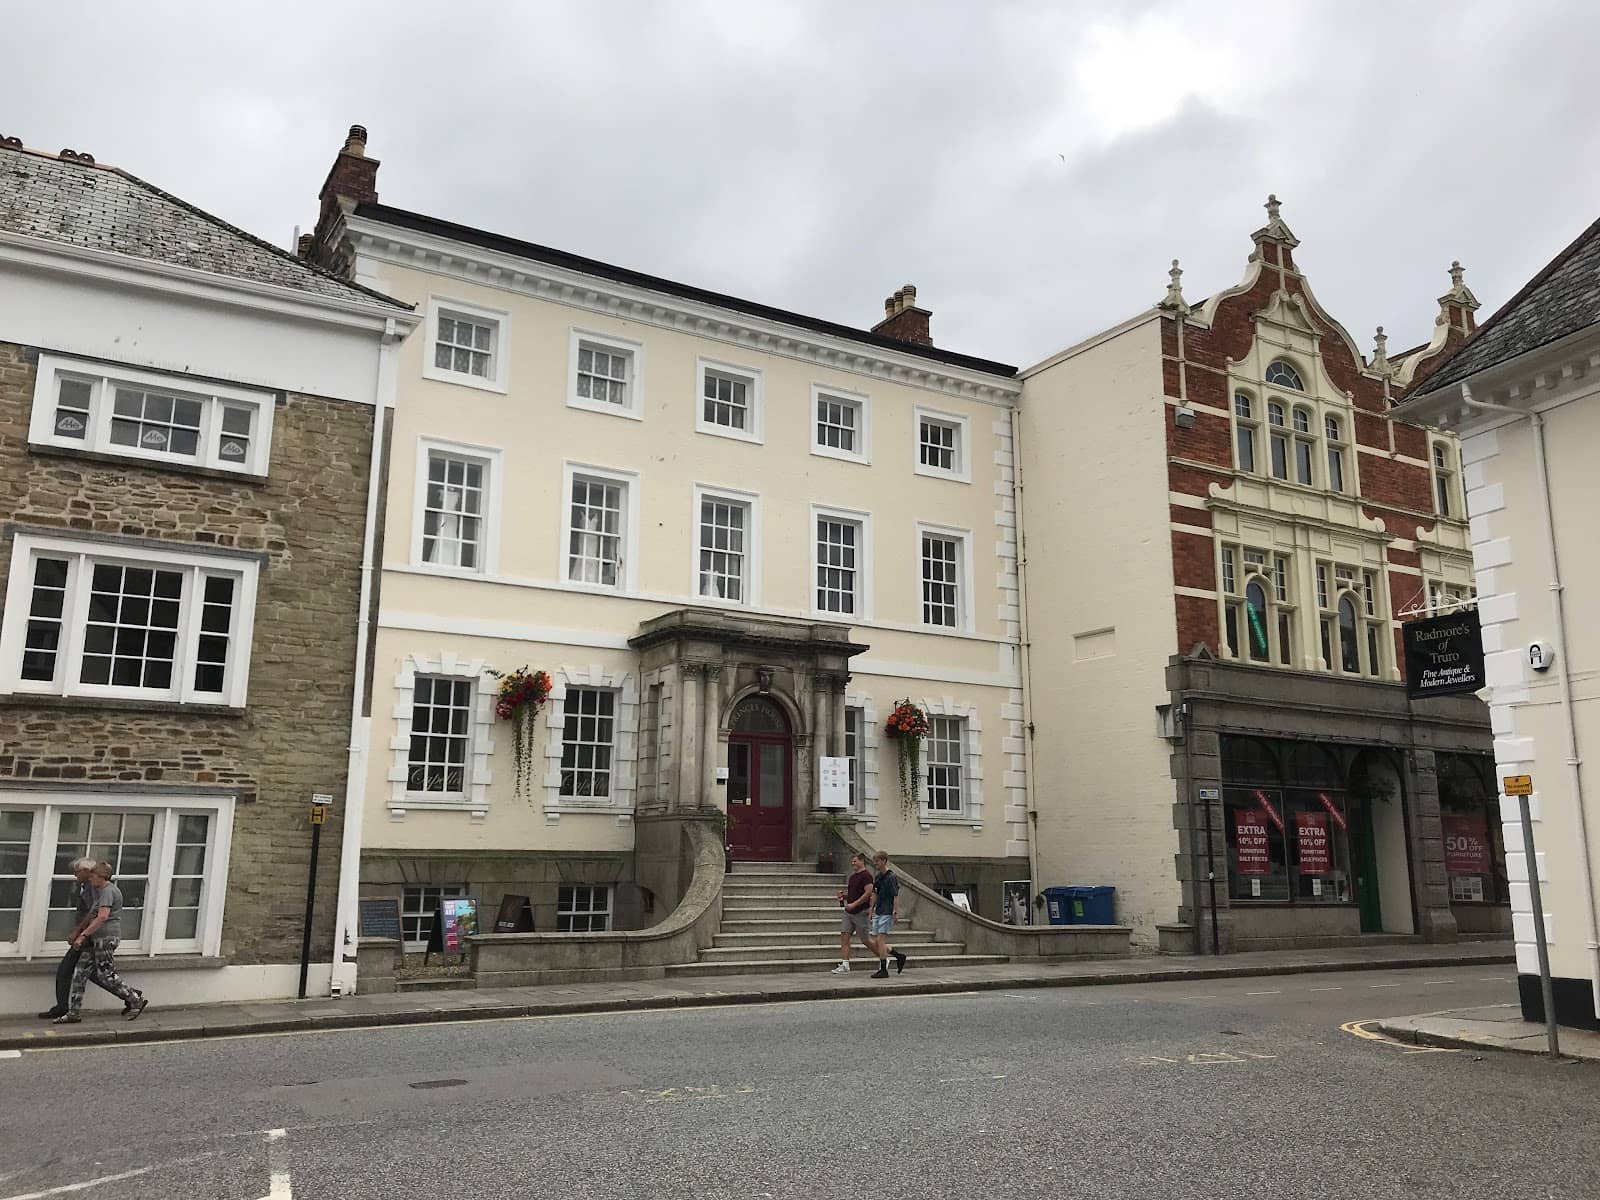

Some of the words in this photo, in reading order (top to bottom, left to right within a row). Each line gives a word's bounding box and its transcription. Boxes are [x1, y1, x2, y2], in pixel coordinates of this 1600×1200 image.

[1415, 623, 1470, 641] Radmore's
[1438, 638, 1450, 653] of
[1429, 652, 1460, 664] Truro
[1423, 669, 1438, 679] Fine
[1438, 666, 1463, 677] Antique
[1463, 664, 1471, 673] &
[1420, 677, 1445, 688] Modern
[1445, 673, 1476, 685] Jewellers
[1237, 825, 1266, 835] EXTRA
[1298, 827, 1326, 836] EXTRA
[1238, 837, 1253, 845] 10%
[1253, 837, 1267, 845] OFF
[1299, 838, 1313, 846] 10%
[1313, 838, 1326, 846] OFF
